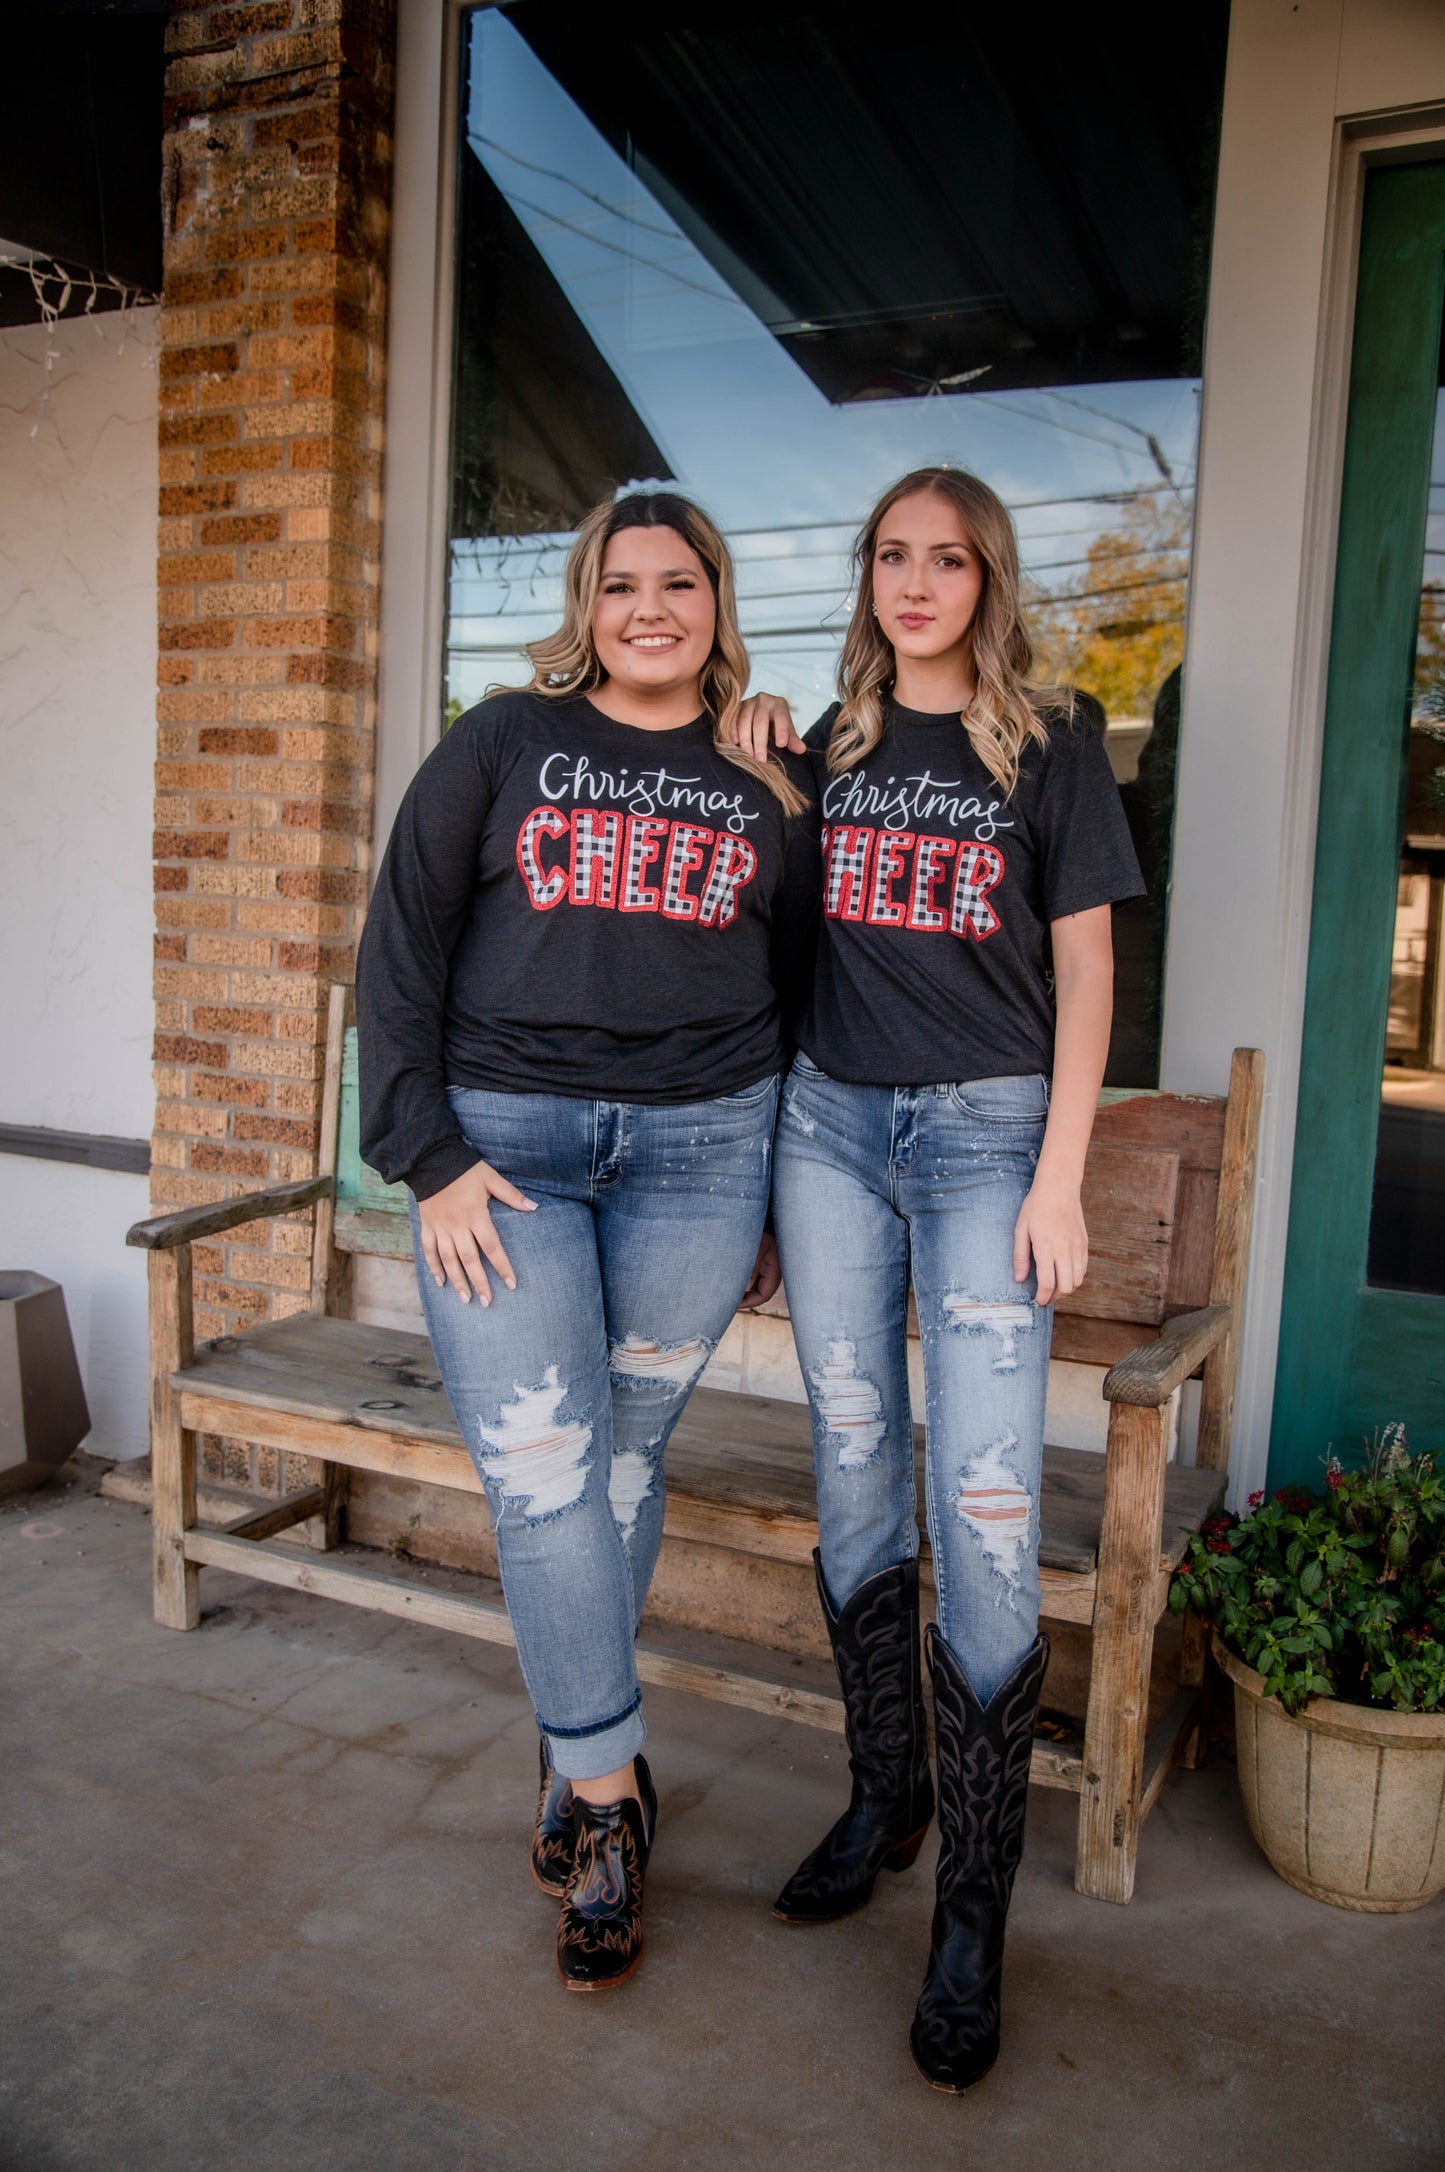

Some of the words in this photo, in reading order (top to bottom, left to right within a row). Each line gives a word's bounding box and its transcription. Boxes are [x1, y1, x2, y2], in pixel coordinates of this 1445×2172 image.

[539, 752, 760, 833] Christmas
[822, 770, 1015, 841] Christmas
[516, 805, 758, 931] CHEER
[821, 823, 1005, 943] HEER
